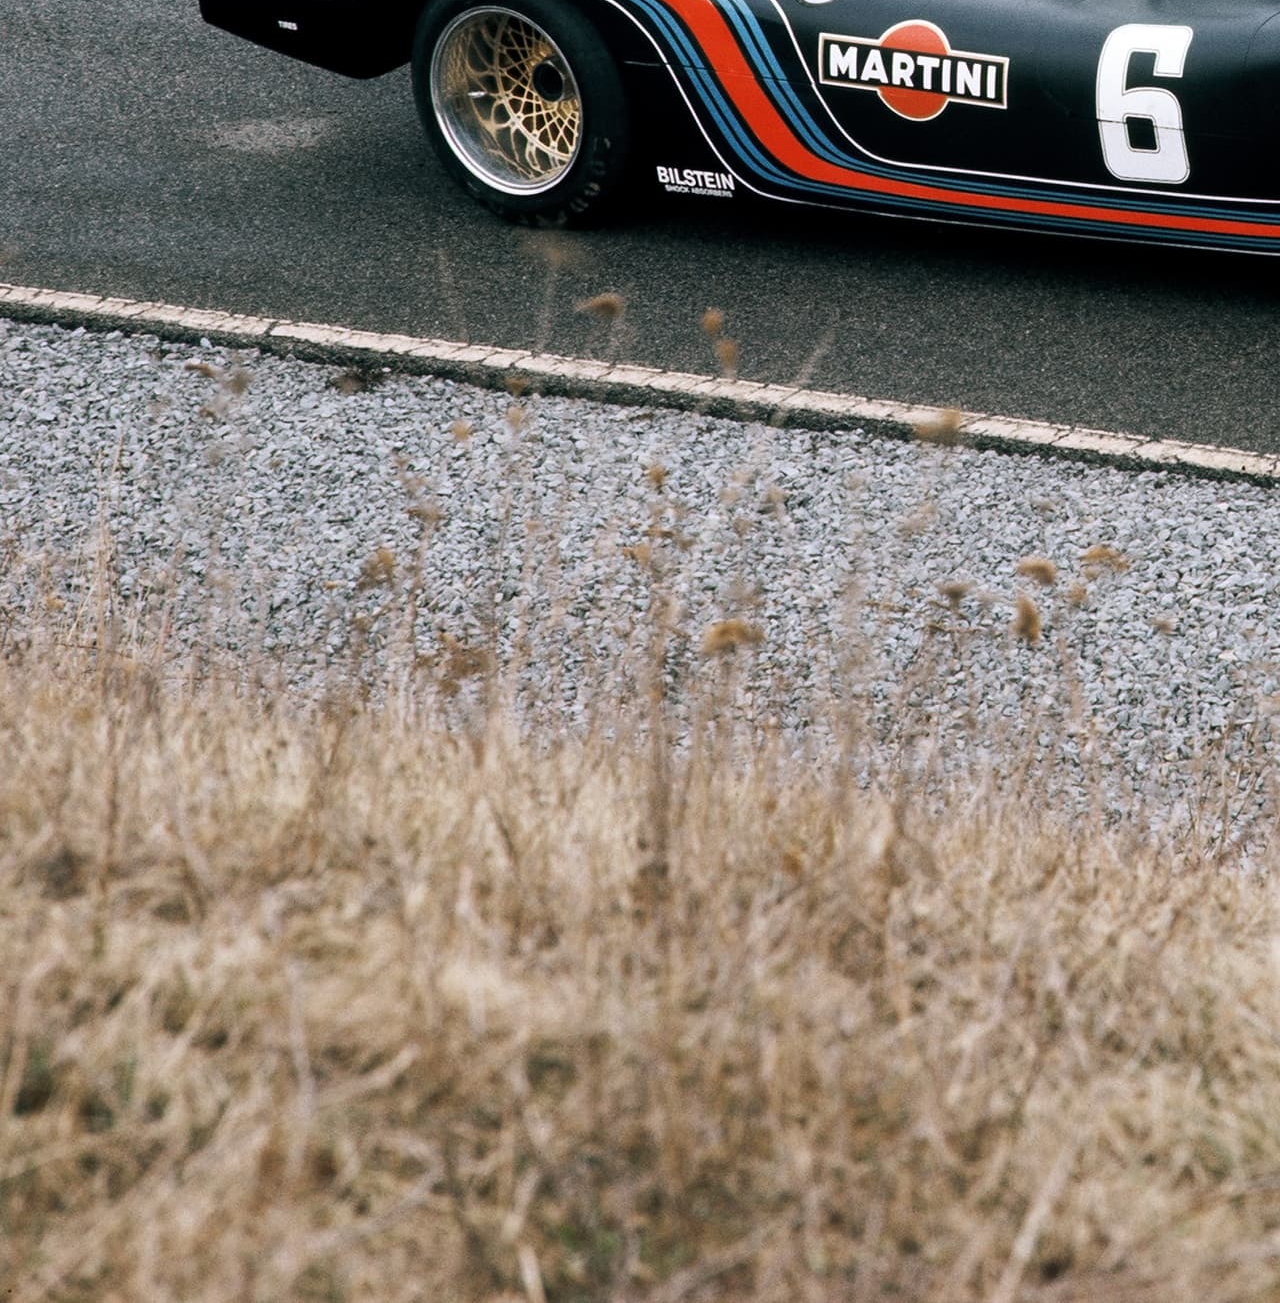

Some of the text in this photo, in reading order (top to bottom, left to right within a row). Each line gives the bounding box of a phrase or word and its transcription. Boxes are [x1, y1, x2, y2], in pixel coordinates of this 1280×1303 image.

[829, 44, 997, 99] MARTINI
[1095, 23, 1194, 185] 6
[656, 165, 735, 190] BILSTEIN
